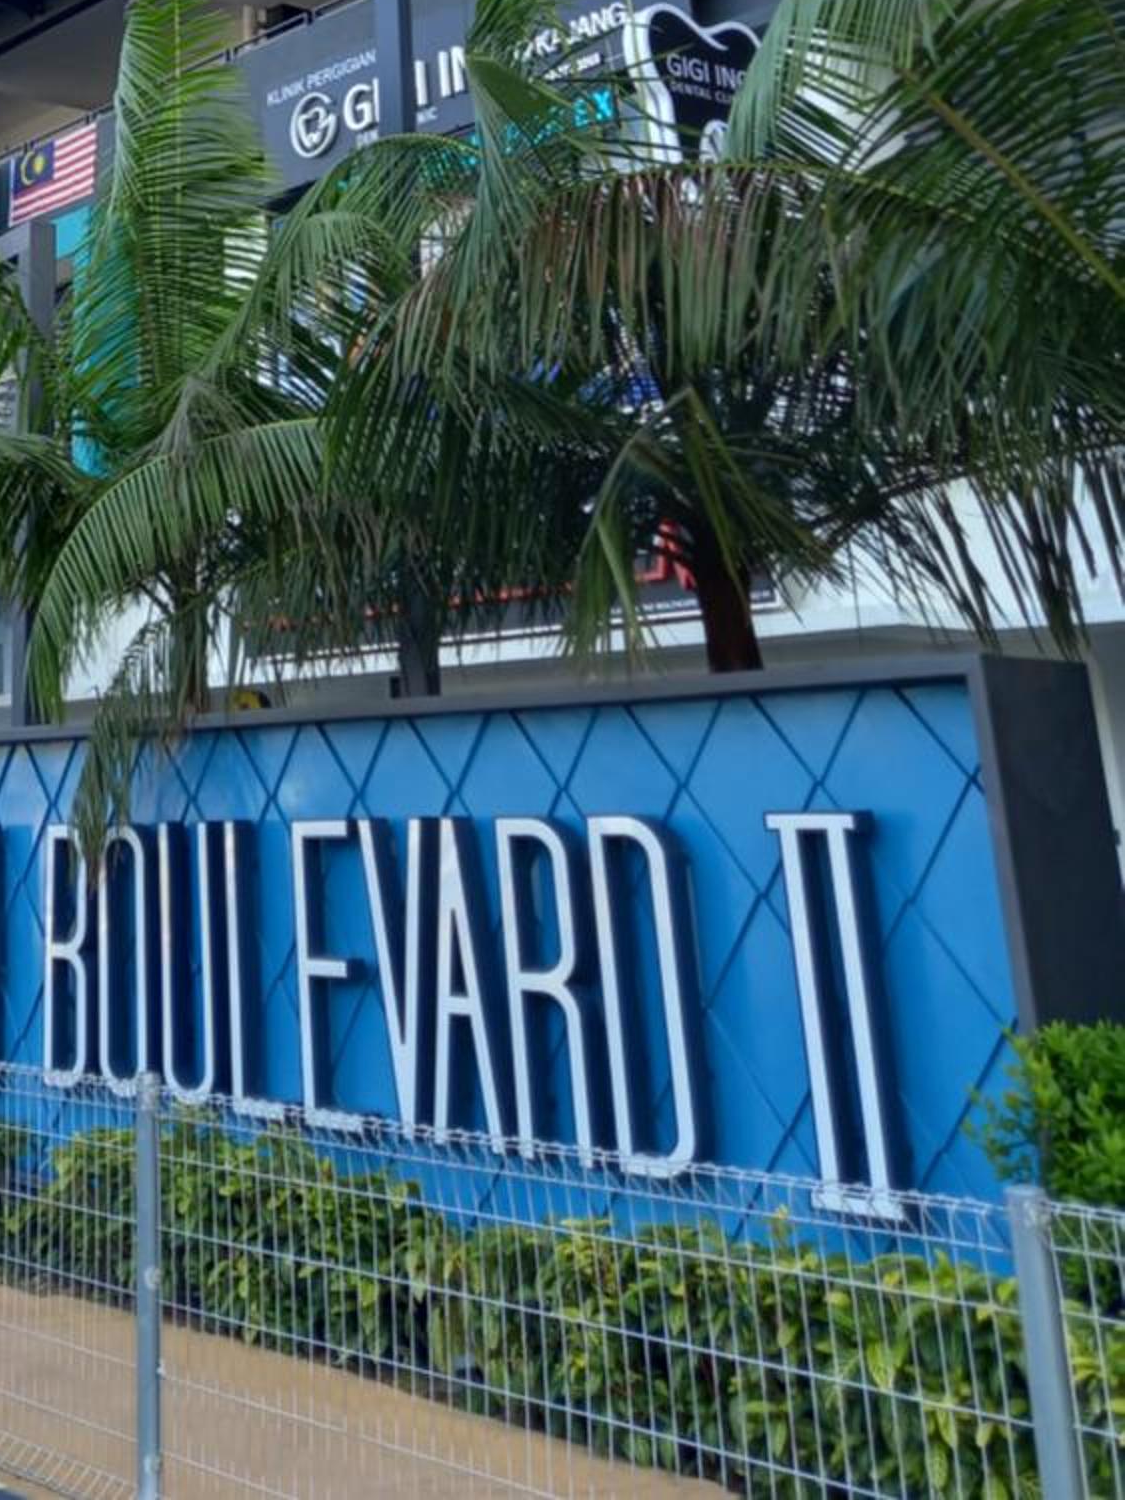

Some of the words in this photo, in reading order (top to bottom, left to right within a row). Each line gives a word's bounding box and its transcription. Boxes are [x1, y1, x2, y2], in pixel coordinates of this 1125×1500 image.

[267, 78, 306, 106] KLINIK
[306, 48, 377, 89] PERGIGIAN
[666, 51, 710, 84] GIGI
[43, 815, 696, 1179] BOULEVARD
[764, 813, 904, 1220] II
